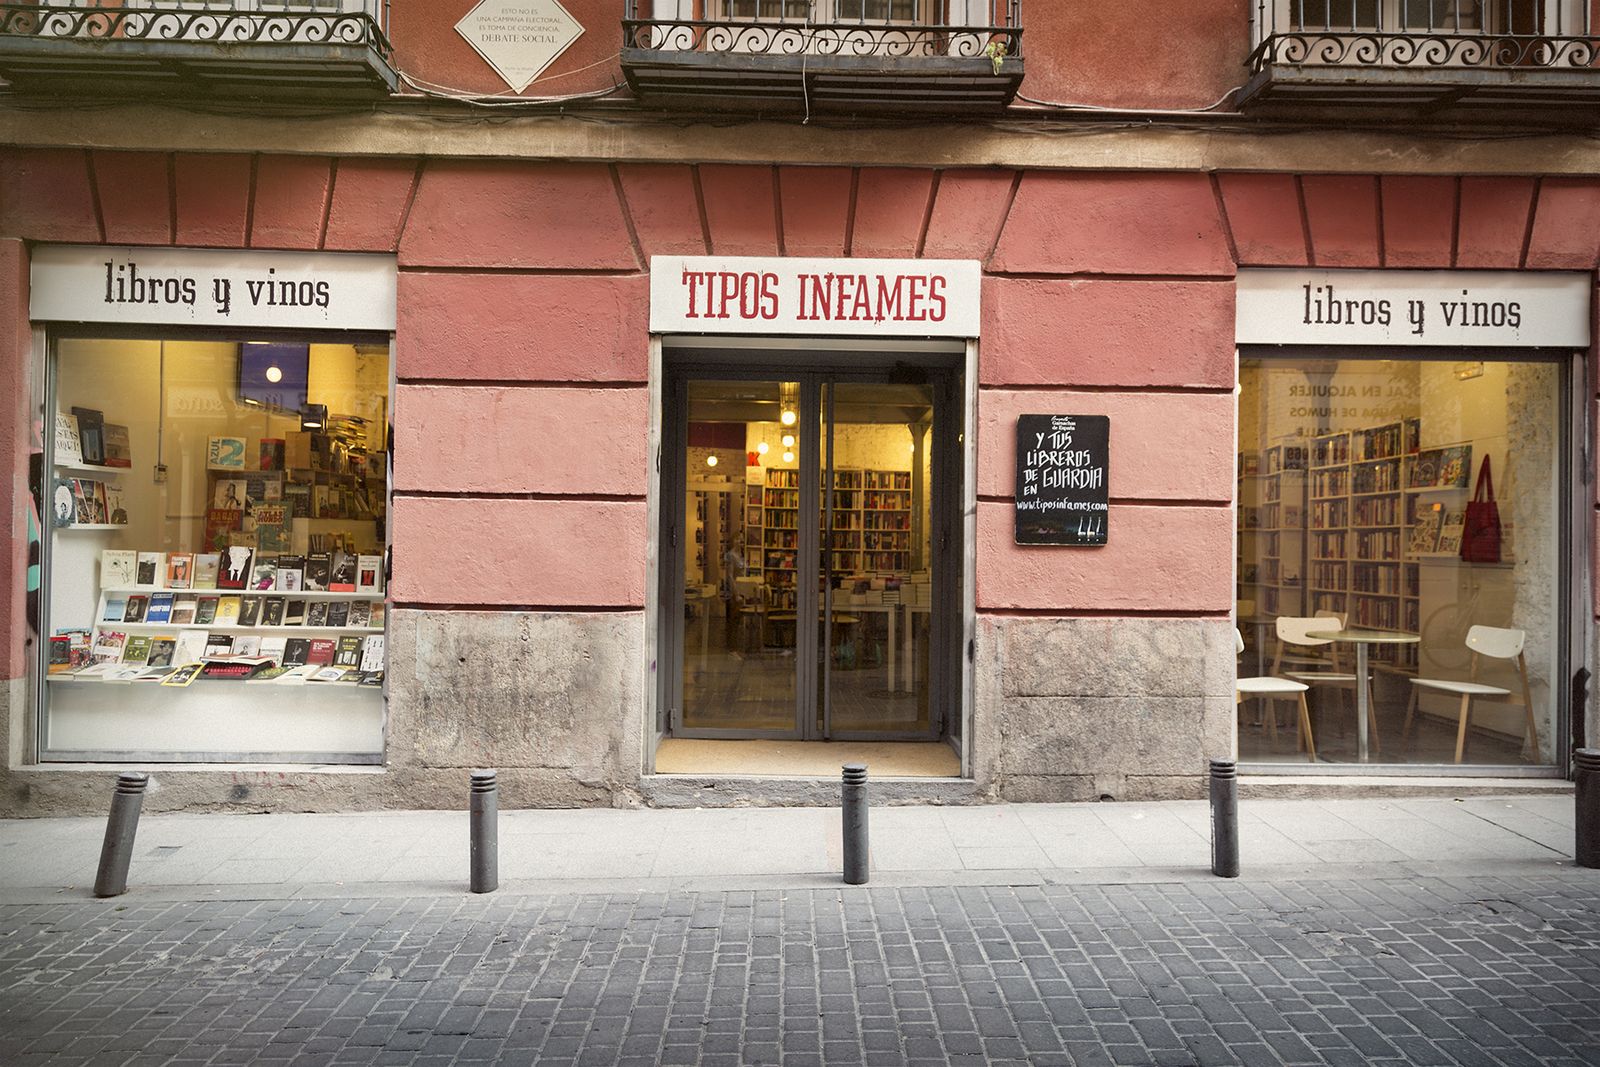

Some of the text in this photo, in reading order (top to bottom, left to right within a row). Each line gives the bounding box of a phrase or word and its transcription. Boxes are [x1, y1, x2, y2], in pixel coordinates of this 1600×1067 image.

[481, 33, 519, 42] DEBATE
[104, 261, 330, 316] libros y vinos
[682, 269, 946, 323] TIPOS INFAMES
[1303, 284, 1521, 337] libros y vinos
[1035, 430, 1072, 449] Y TUS
[210, 438, 244, 466] AZUL 2
[1023, 468, 1039, 483] DE
[1023, 484, 1038, 496] EN
[1017, 497, 1108, 513] www.tiposinfames.com
